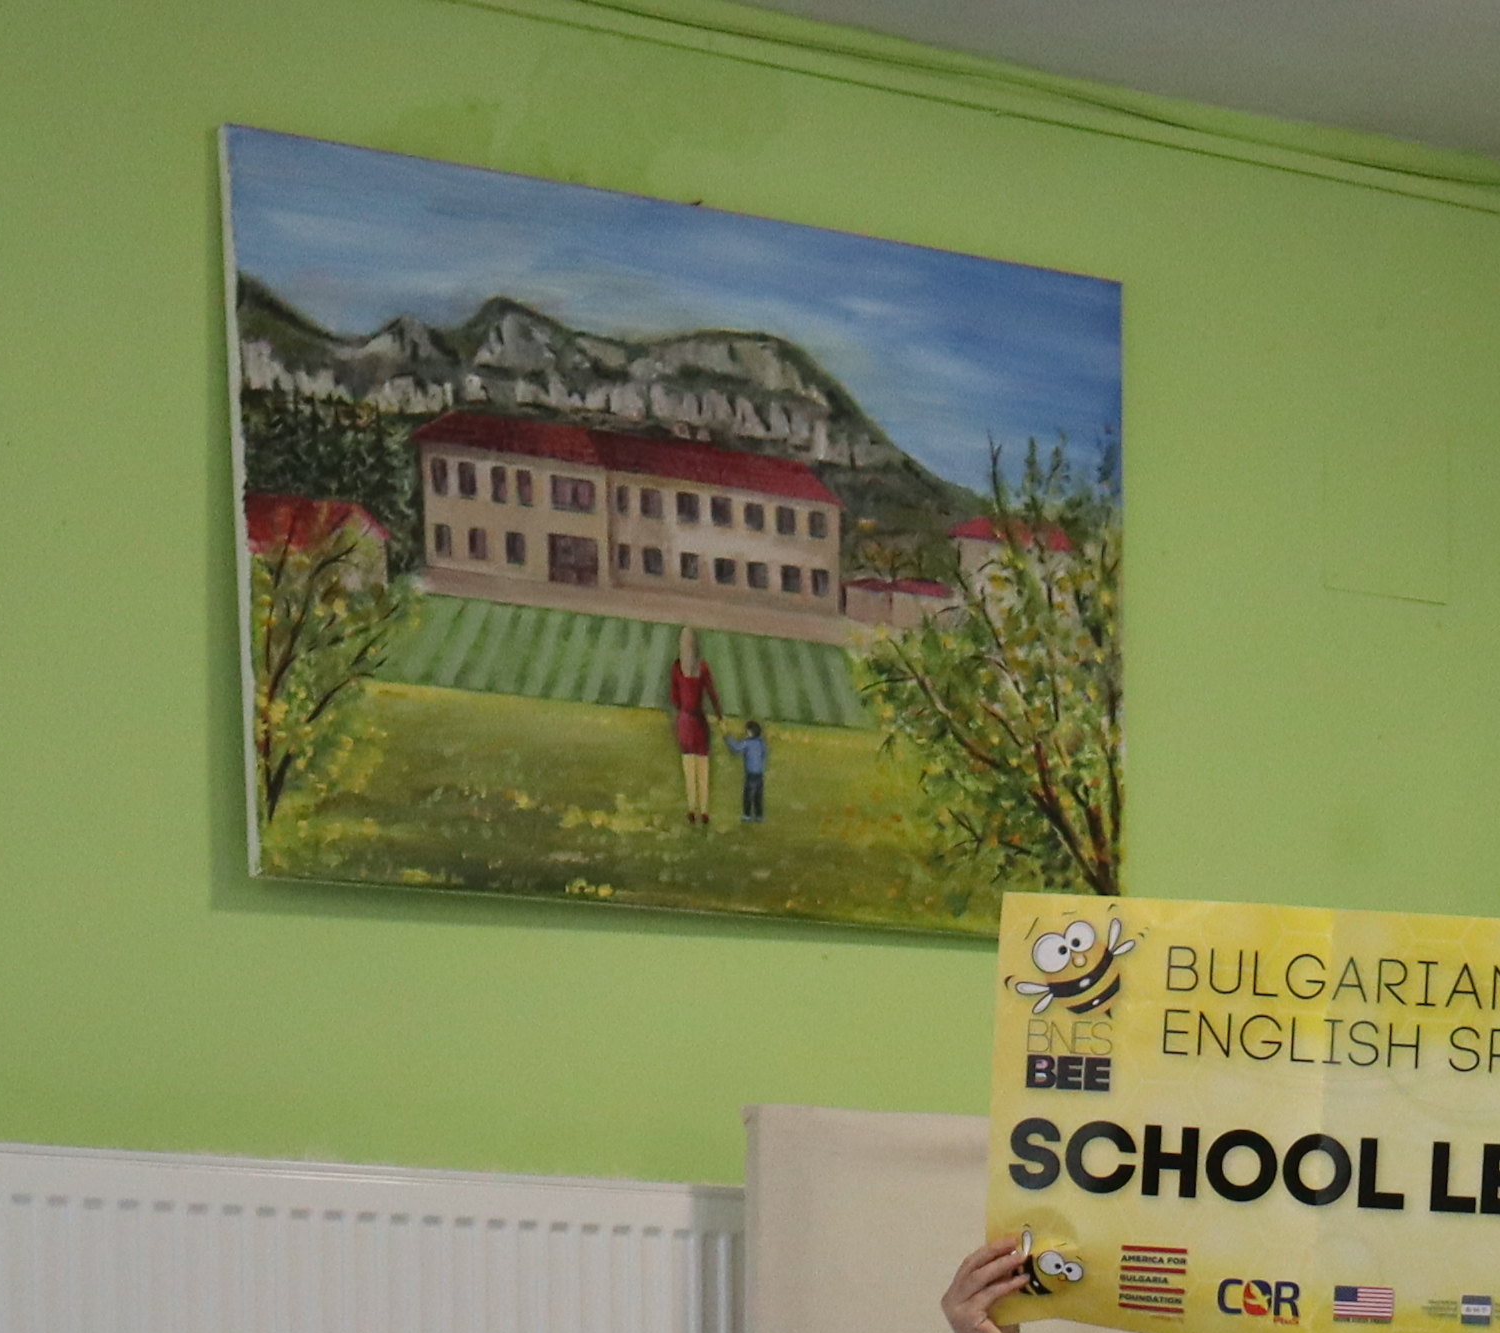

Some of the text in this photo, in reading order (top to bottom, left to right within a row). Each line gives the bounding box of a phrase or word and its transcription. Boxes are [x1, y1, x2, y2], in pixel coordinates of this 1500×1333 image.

[1026, 1019, 1112, 1055] BNES
[1162, 1009, 1420, 1069] ENGLISH
[1025, 1054, 1111, 1091] BEE
[1009, 1117, 1405, 1211] SCHOOL
[1120, 1255, 1187, 1265] AMERICA FOR
[1119, 1274, 1169, 1284] BULGARIA
[1119, 1293, 1182, 1304] FOUNDATION
